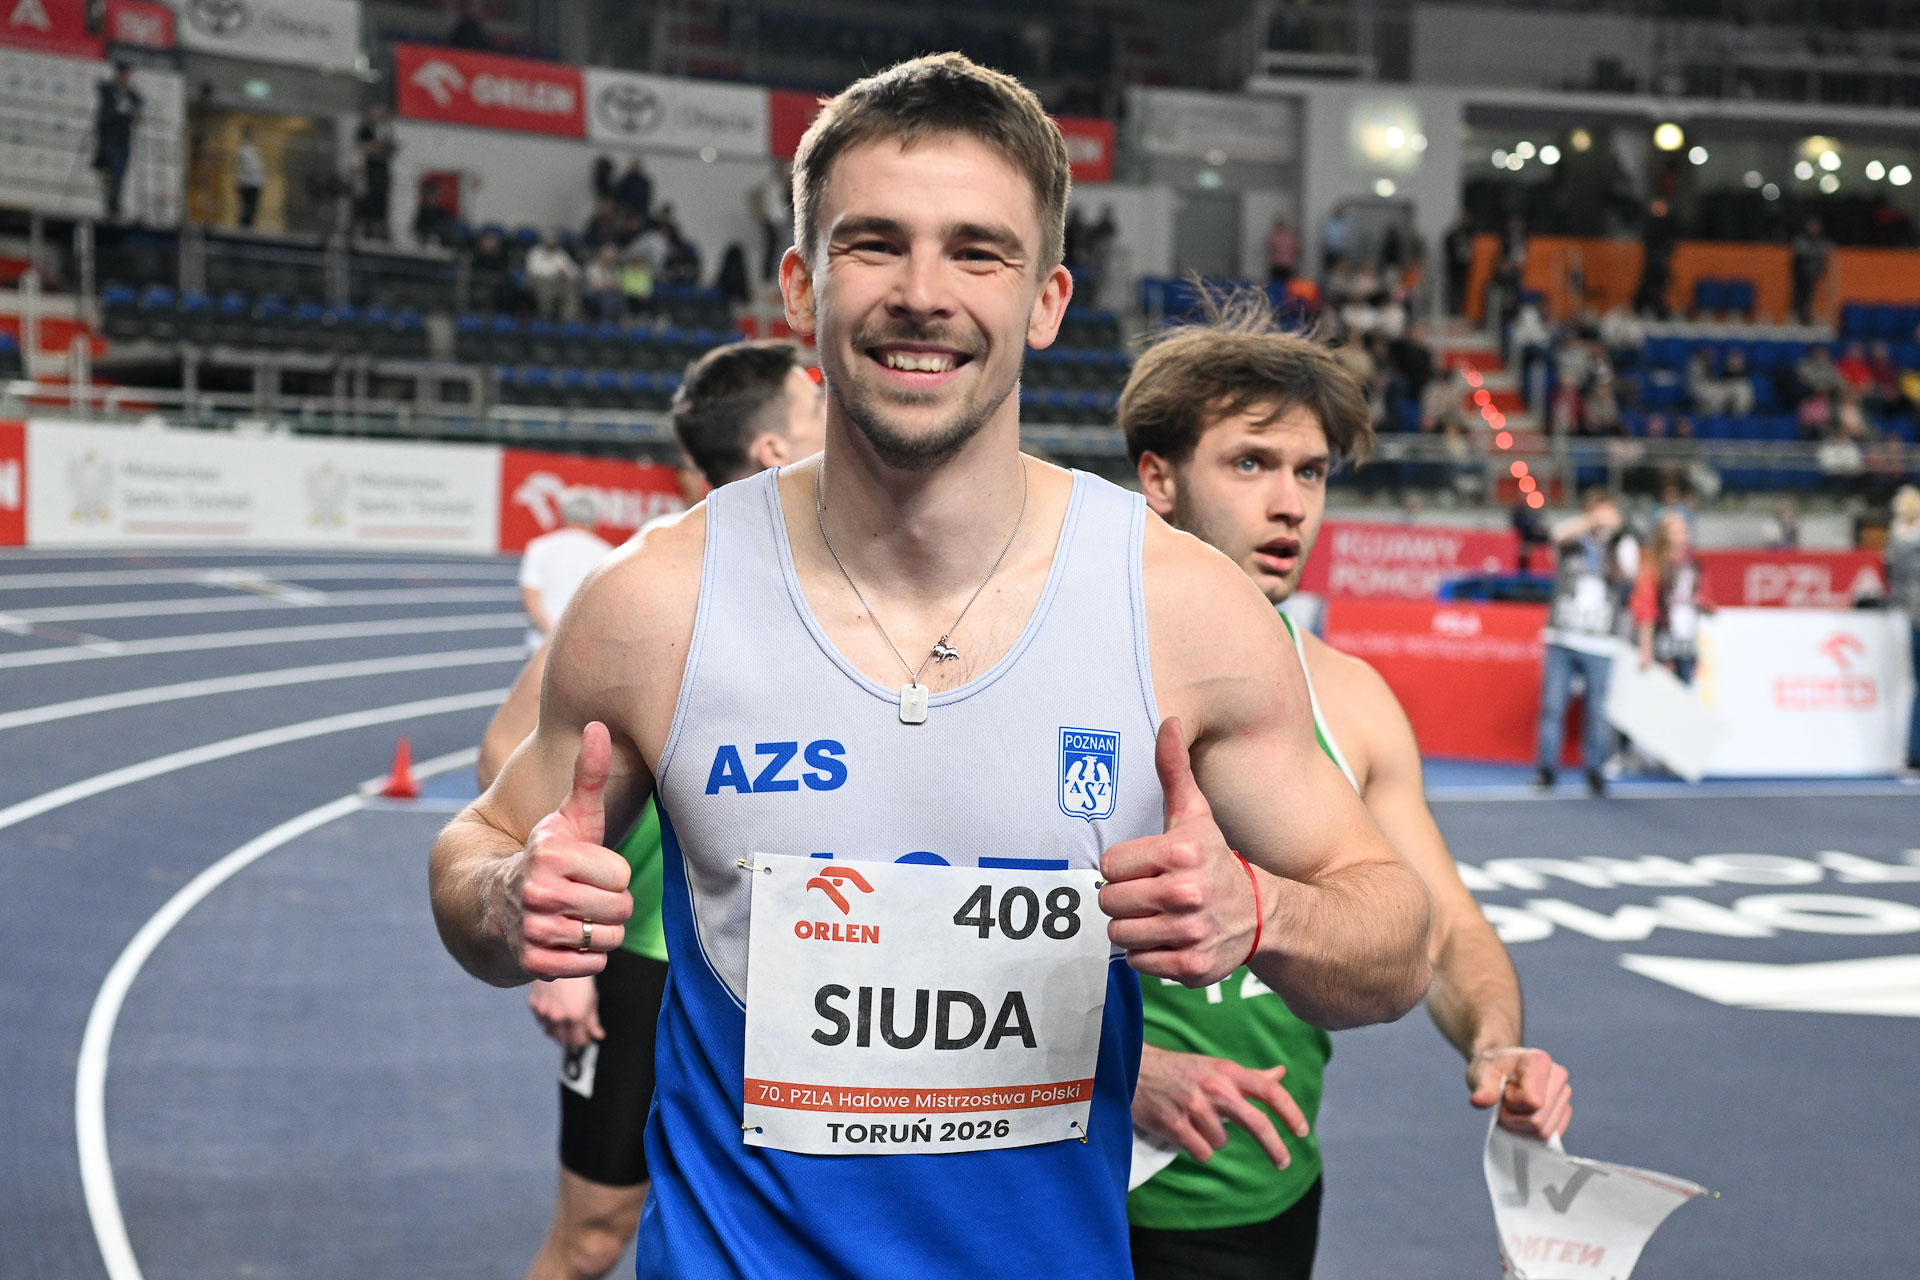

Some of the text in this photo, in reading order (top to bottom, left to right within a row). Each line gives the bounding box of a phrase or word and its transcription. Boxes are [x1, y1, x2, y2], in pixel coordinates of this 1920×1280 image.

[471, 75, 576, 115] ORLEN
[1065, 735, 1114, 752] POZNAŃ
[706, 739, 847, 795] AZS
[953, 885, 1081, 940] 408
[794, 920, 880, 944] ORLEN
[811, 984, 1037, 1050] SIUDA
[758, 1084, 1080, 1108] 70. PZLA Halowe Mistrzostwa Polski
[827, 1118, 1010, 1143] TORUŃ 2026
